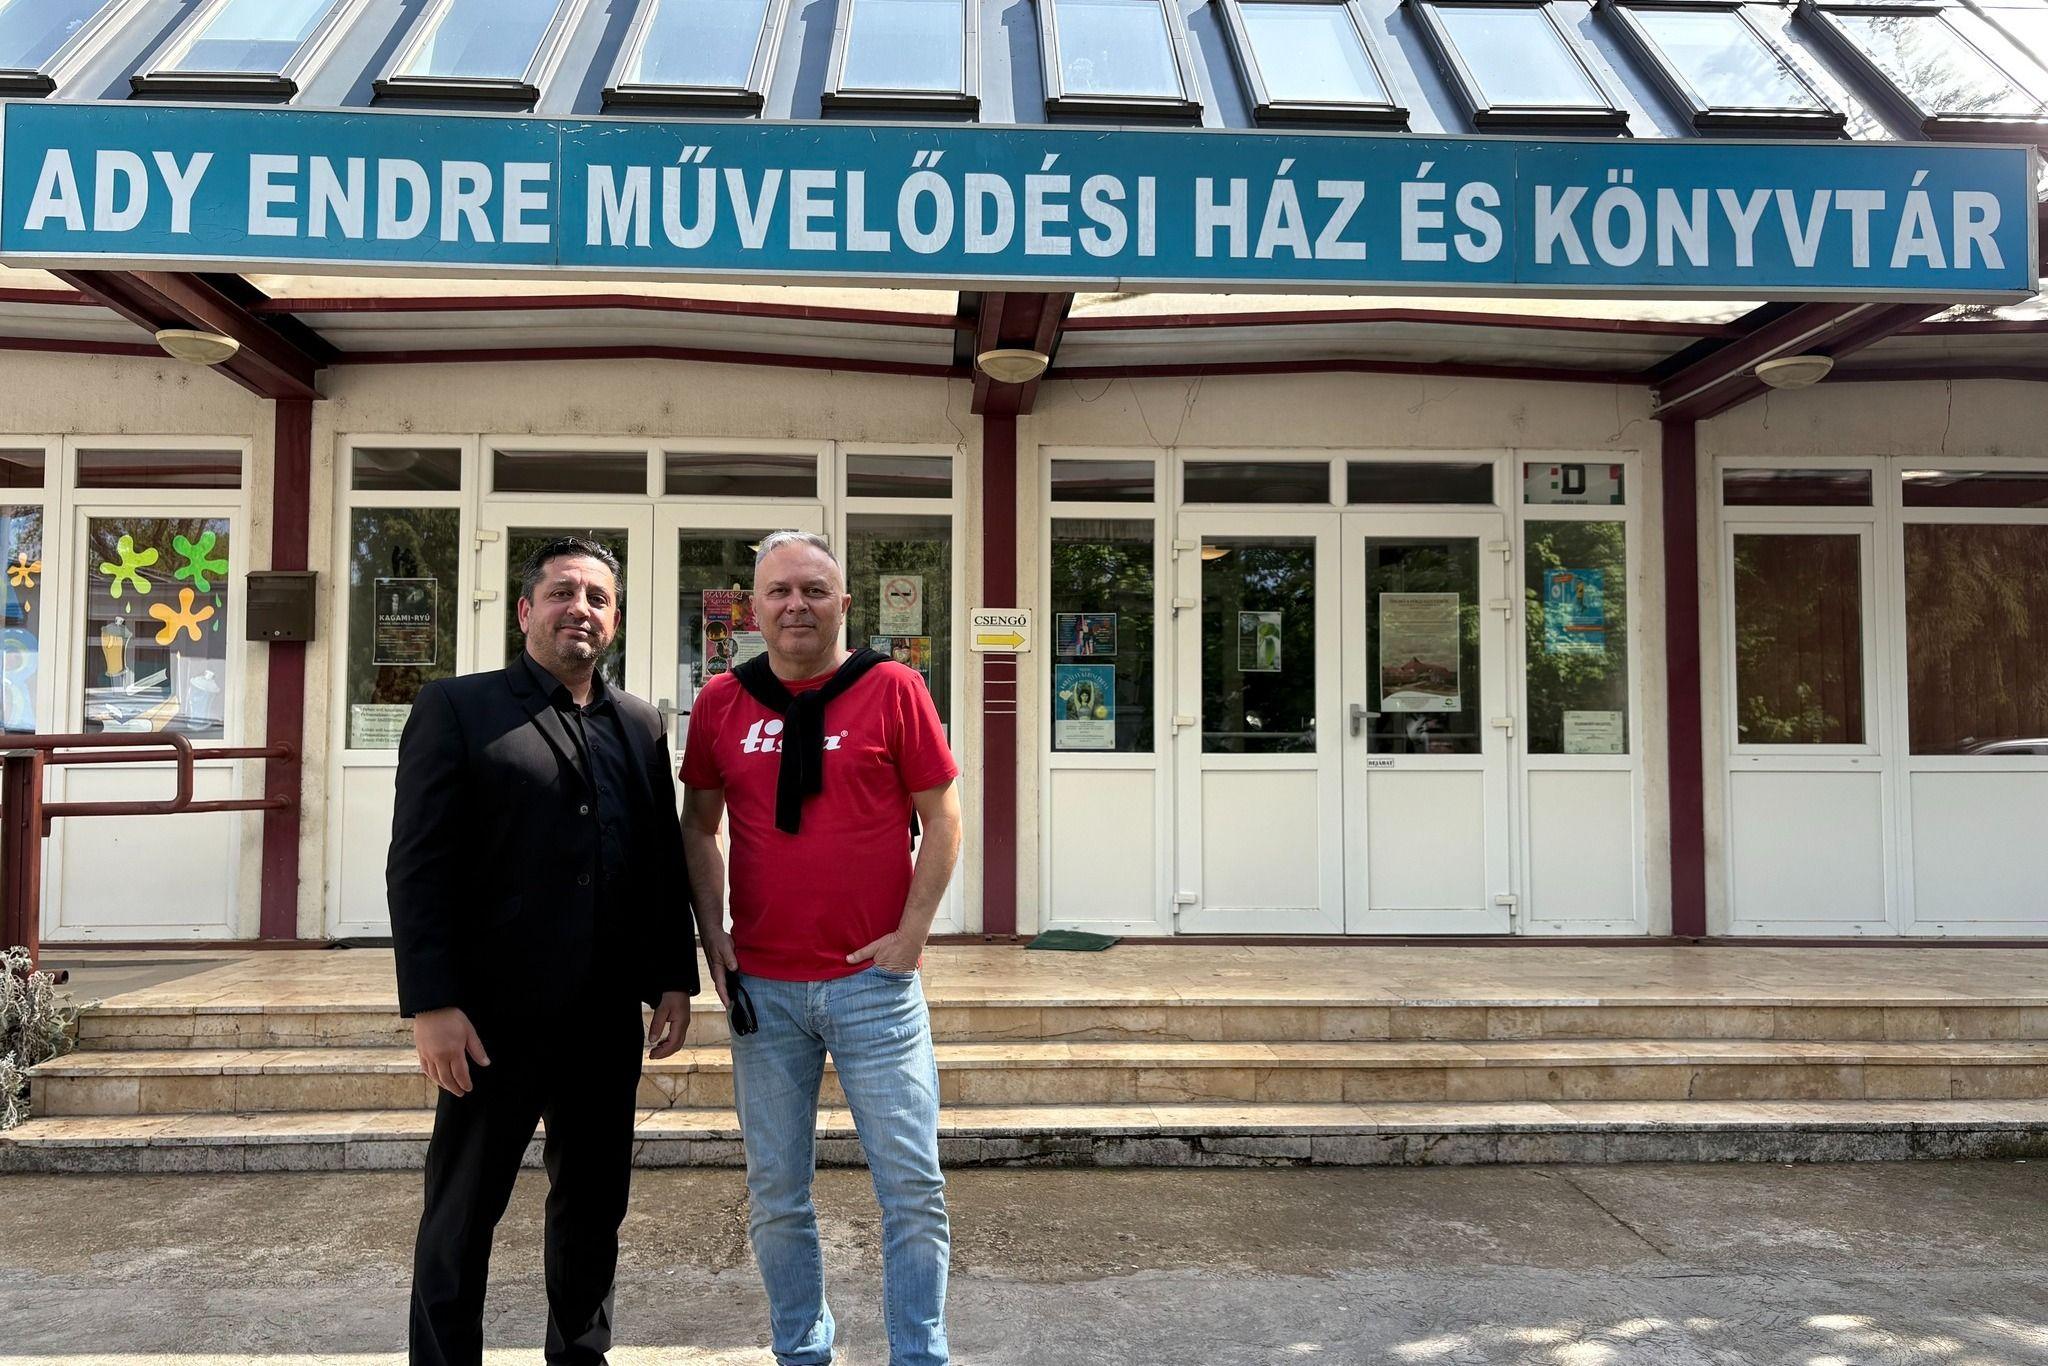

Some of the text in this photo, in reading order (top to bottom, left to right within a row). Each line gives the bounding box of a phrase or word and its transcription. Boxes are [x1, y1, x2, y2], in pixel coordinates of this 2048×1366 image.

[24, 145, 2005, 270] ADY ENDRE MŰVELŐDÉSI HÁZ ÉS KÖNYVTÁR
[974, 614, 1027, 626] CSENGŐ
